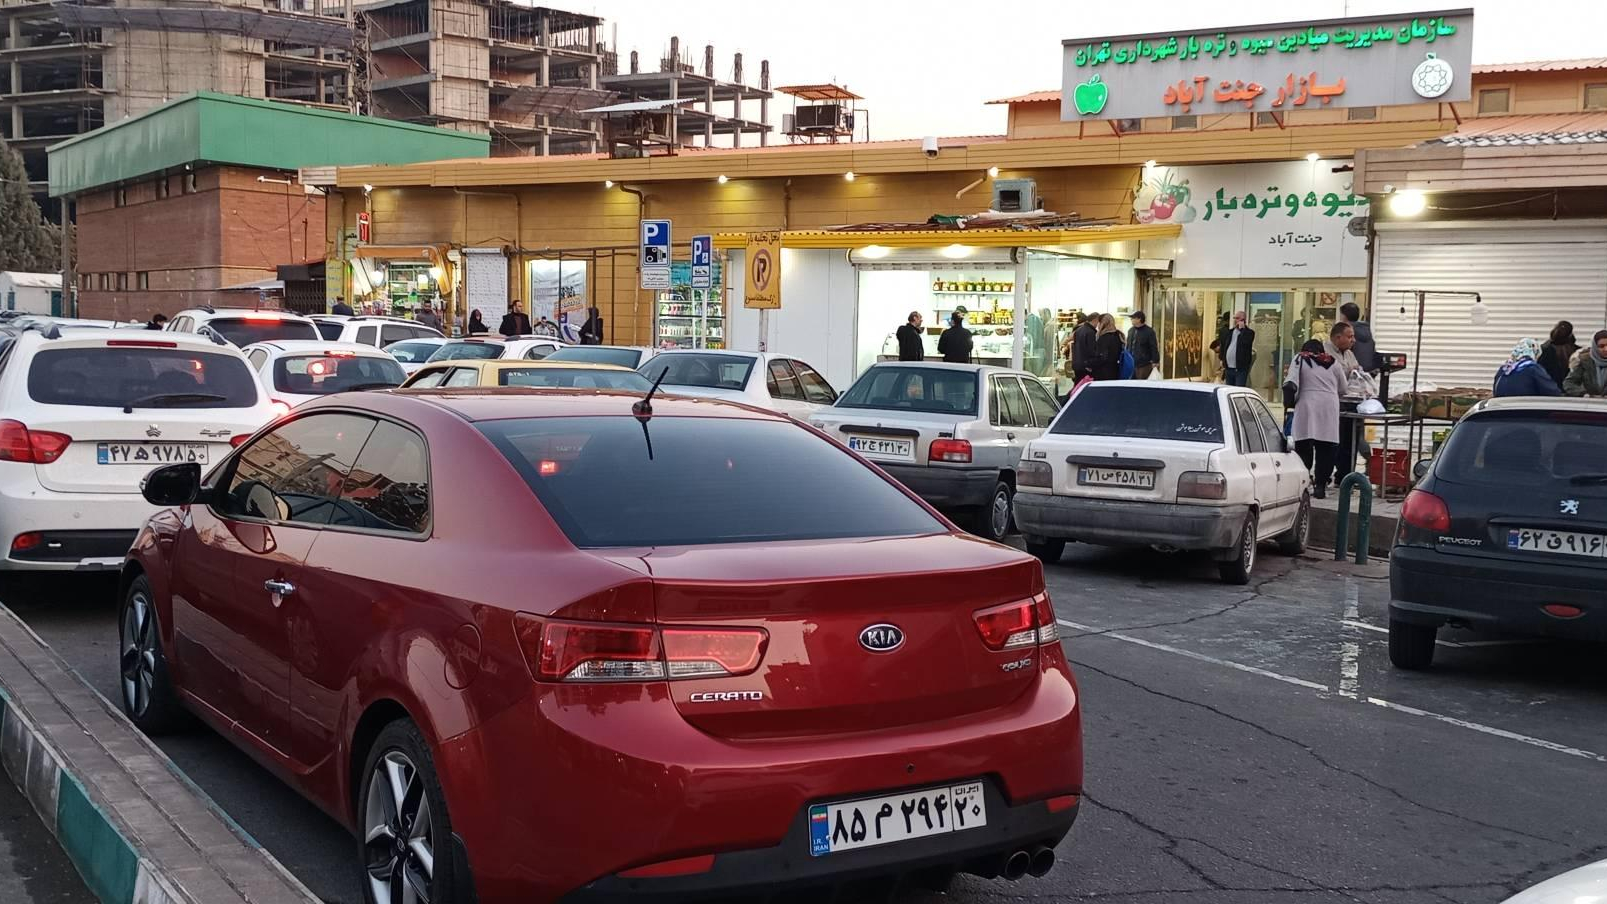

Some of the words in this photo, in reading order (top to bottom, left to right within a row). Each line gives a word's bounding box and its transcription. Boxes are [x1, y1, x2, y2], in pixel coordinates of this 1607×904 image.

[1276, 26, 1330, 52] میادین
[1332, 25, 1394, 48] مدیریت
[1396, 17, 1457, 44] سازمان
[1074, 41, 1112, 67] تهران
[1113, 36, 1178, 64] شهرداری
[1179, 34, 1200, 61] بار
[1203, 32, 1226, 58] تره
[1229, 40, 1237, 57] و
[1240, 34, 1275, 54] میوه
[1163, 76, 1210, 113] آباد
[1213, 79, 1266, 109] جنت
[1271, 71, 1346, 107] بازار
[644, 223, 659, 244] P
[1269, 232, 1292, 247] آباد
[1294, 233, 1322, 247] جنت
[694, 240, 702, 264] P
[110, 445, 130, 461] ۴۷
[152, 445, 183, 462] ۹۷۸
[1438, 536, 1483, 546] PEUGEOT
[1546, 533, 1562, 549] ق
[1566, 536, 1601, 553] ۹۱۶
[867, 629, 897, 646] KIA
[691, 691, 762, 702] CERATO
[955, 785, 979, 796] ایران
[832, 808, 866, 845] ۸۵
[875, 802, 893, 839] م
[901, 794, 948, 833] ۲۹۴
[954, 796, 981, 826] ۲۰
[813, 843, 829, 851] IRAN
